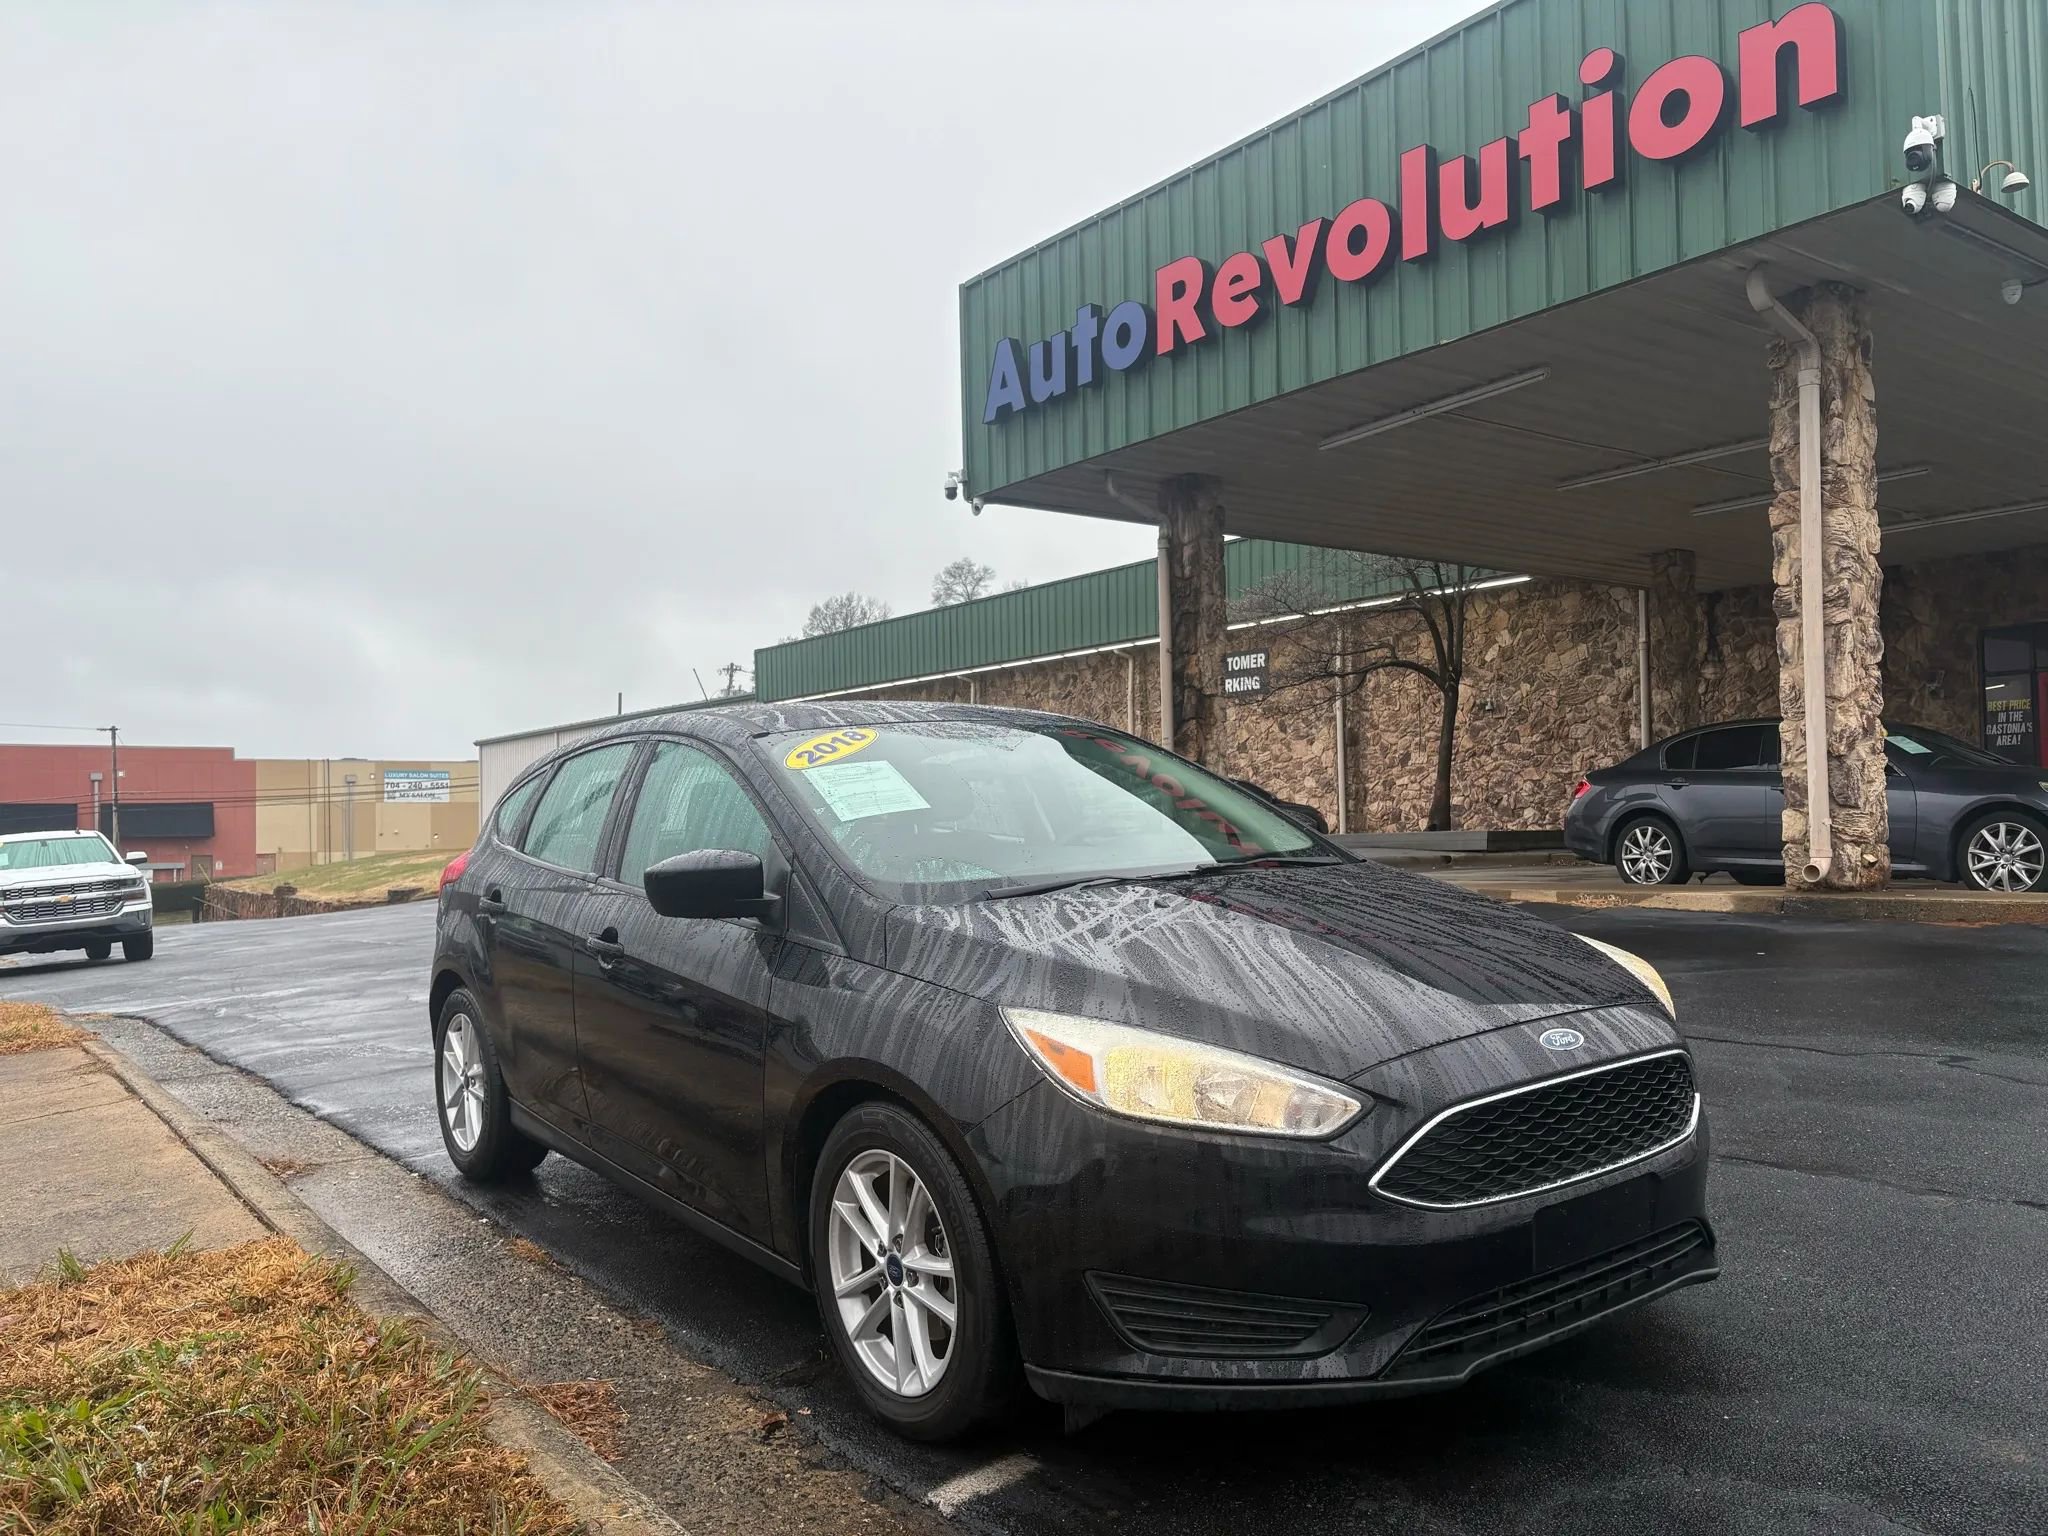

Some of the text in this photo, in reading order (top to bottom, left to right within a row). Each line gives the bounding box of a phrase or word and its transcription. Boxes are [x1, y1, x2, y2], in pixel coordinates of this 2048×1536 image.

[1987, 699, 2031, 712] BEST PRICE
[1998, 711, 2023, 722] IN THE
[1986, 722, 2032, 735] GASTONIA'S
[795, 730, 869, 764] 2018
[1996, 735, 2021, 746] AREA!
[1550, 1032, 1576, 1046] Ford
